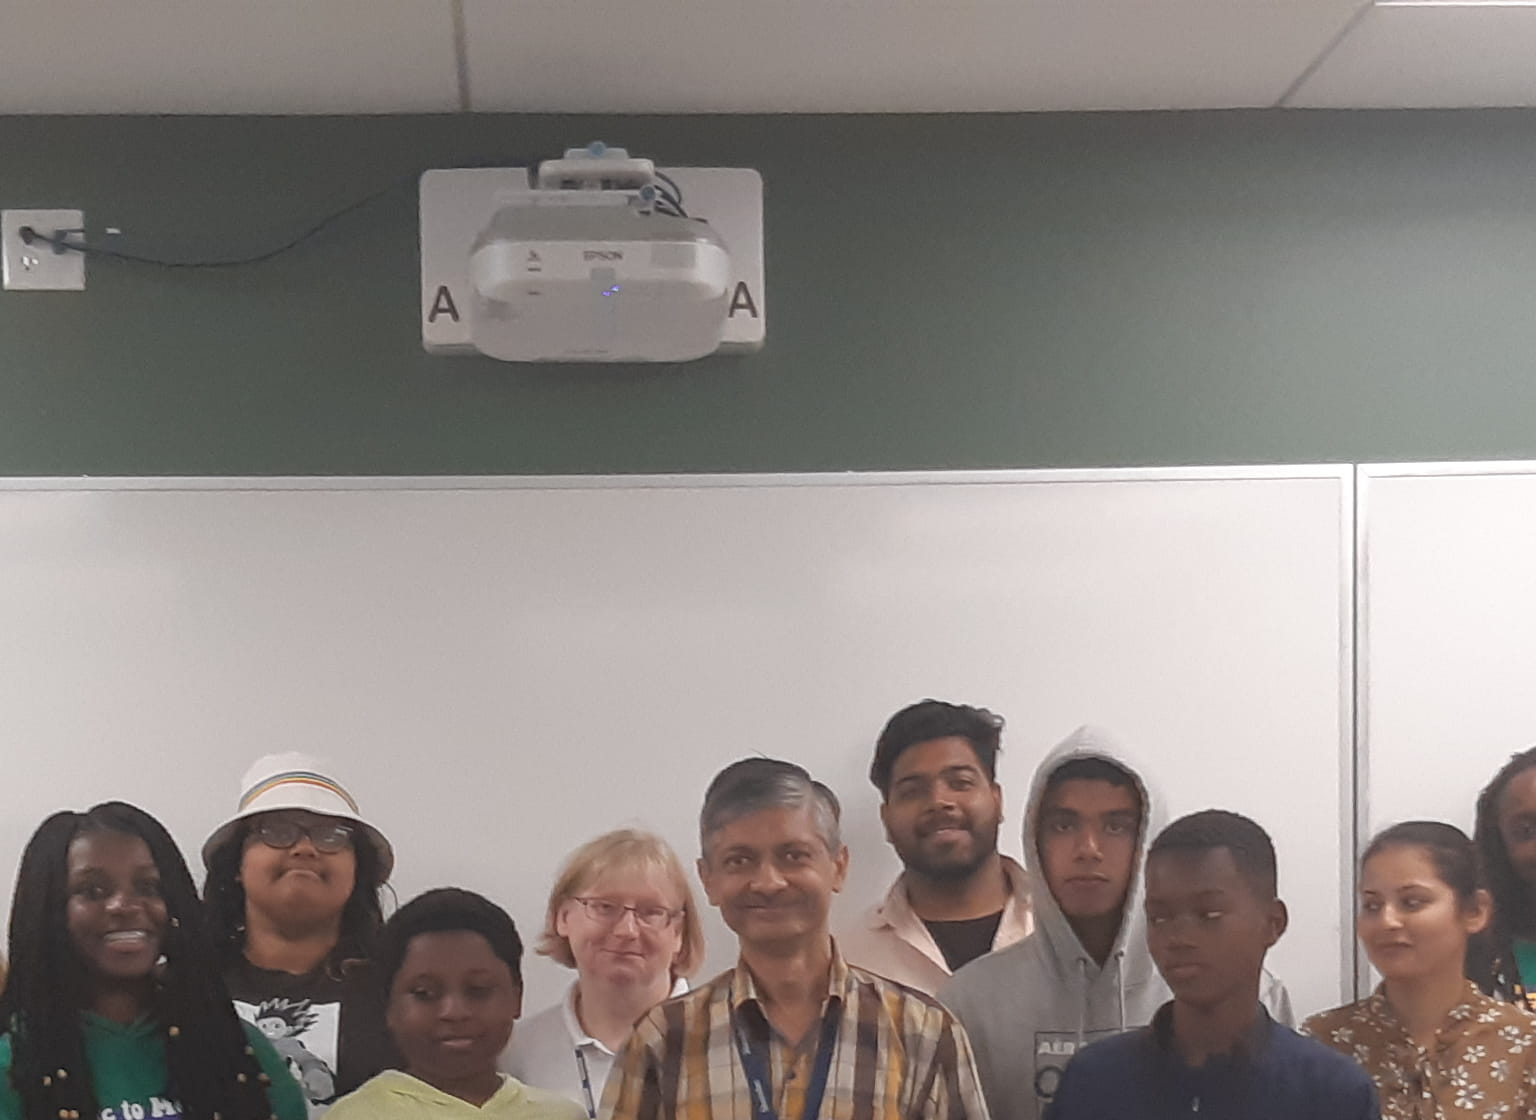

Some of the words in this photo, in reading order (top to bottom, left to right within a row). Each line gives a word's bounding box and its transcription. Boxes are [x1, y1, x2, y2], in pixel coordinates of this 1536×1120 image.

[428, 285, 459, 323] A
[728, 281, 758, 318] A
[121, 1099, 145, 1120] to
